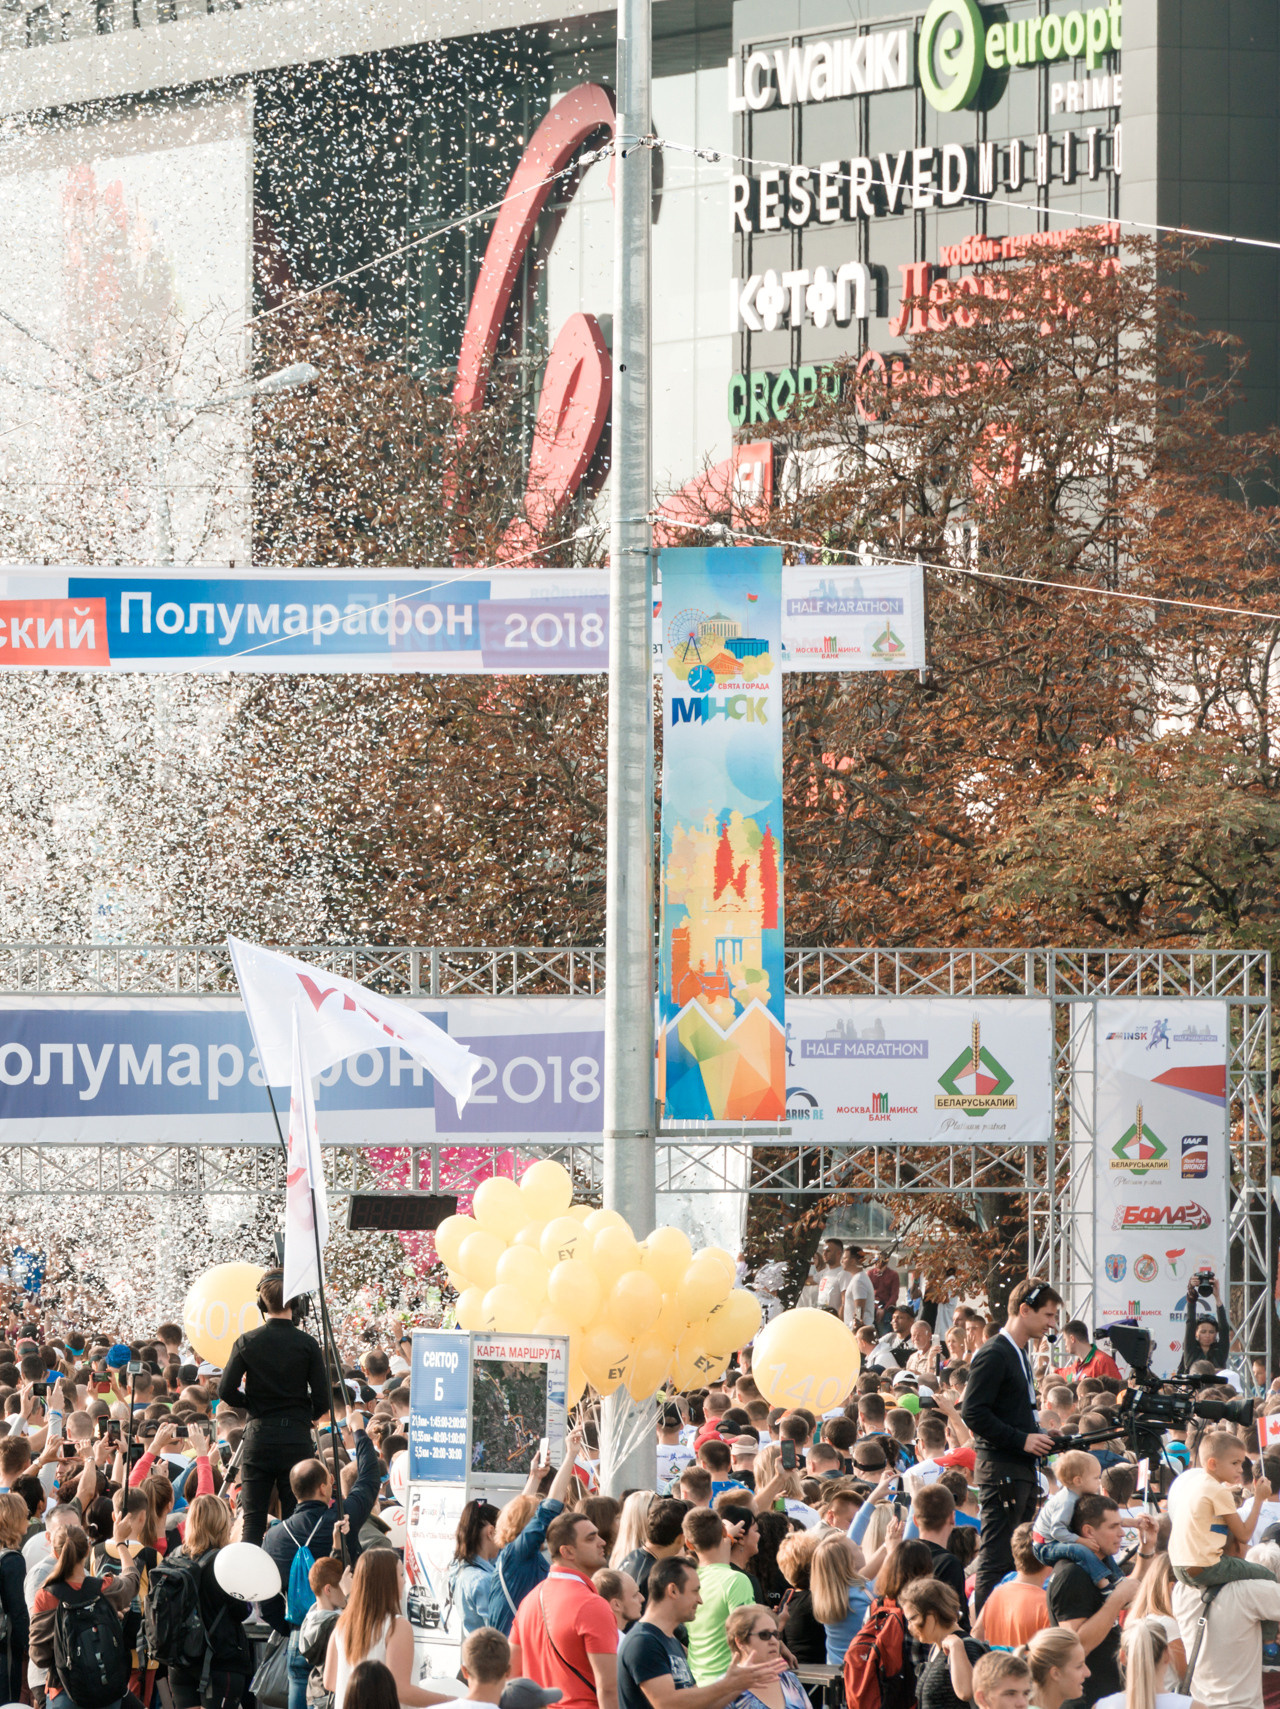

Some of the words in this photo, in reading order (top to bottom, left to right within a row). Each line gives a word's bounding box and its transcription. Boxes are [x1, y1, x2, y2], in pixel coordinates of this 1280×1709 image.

[985, 2, 1121, 69] euroopt
[1050, 75, 1121, 114] PRIME
[978, 123, 1121, 195] MOHITO
[728, 144, 968, 234] RESERVED
[791, 602, 824, 613] HALF
[827, 601, 899, 613] MARATHON
[120, 591, 473, 646] Полумарафон
[504, 612, 605, 648] 2018
[806, 1042, 840, 1056] HALF
[844, 1042, 924, 1056] MARATHON
[468, 1055, 601, 1104] 2018
[937, 1098, 1015, 1107] БЕЛАРУСЬКАЛИЙ
[812, 1109, 824, 1120] RE
[1122, 1206, 1187, 1224] БФЛА
[558, 1248, 575, 1262] EY
[423, 1350, 459, 1374] сектор
[477, 1345, 507, 1359] КАРТА
[508, 1346, 562, 1361] МАРШРУТА
[608, 1366, 626, 1380] EY
[694, 1355, 715, 1373] EY
[434, 1377, 444, 1401] Б
